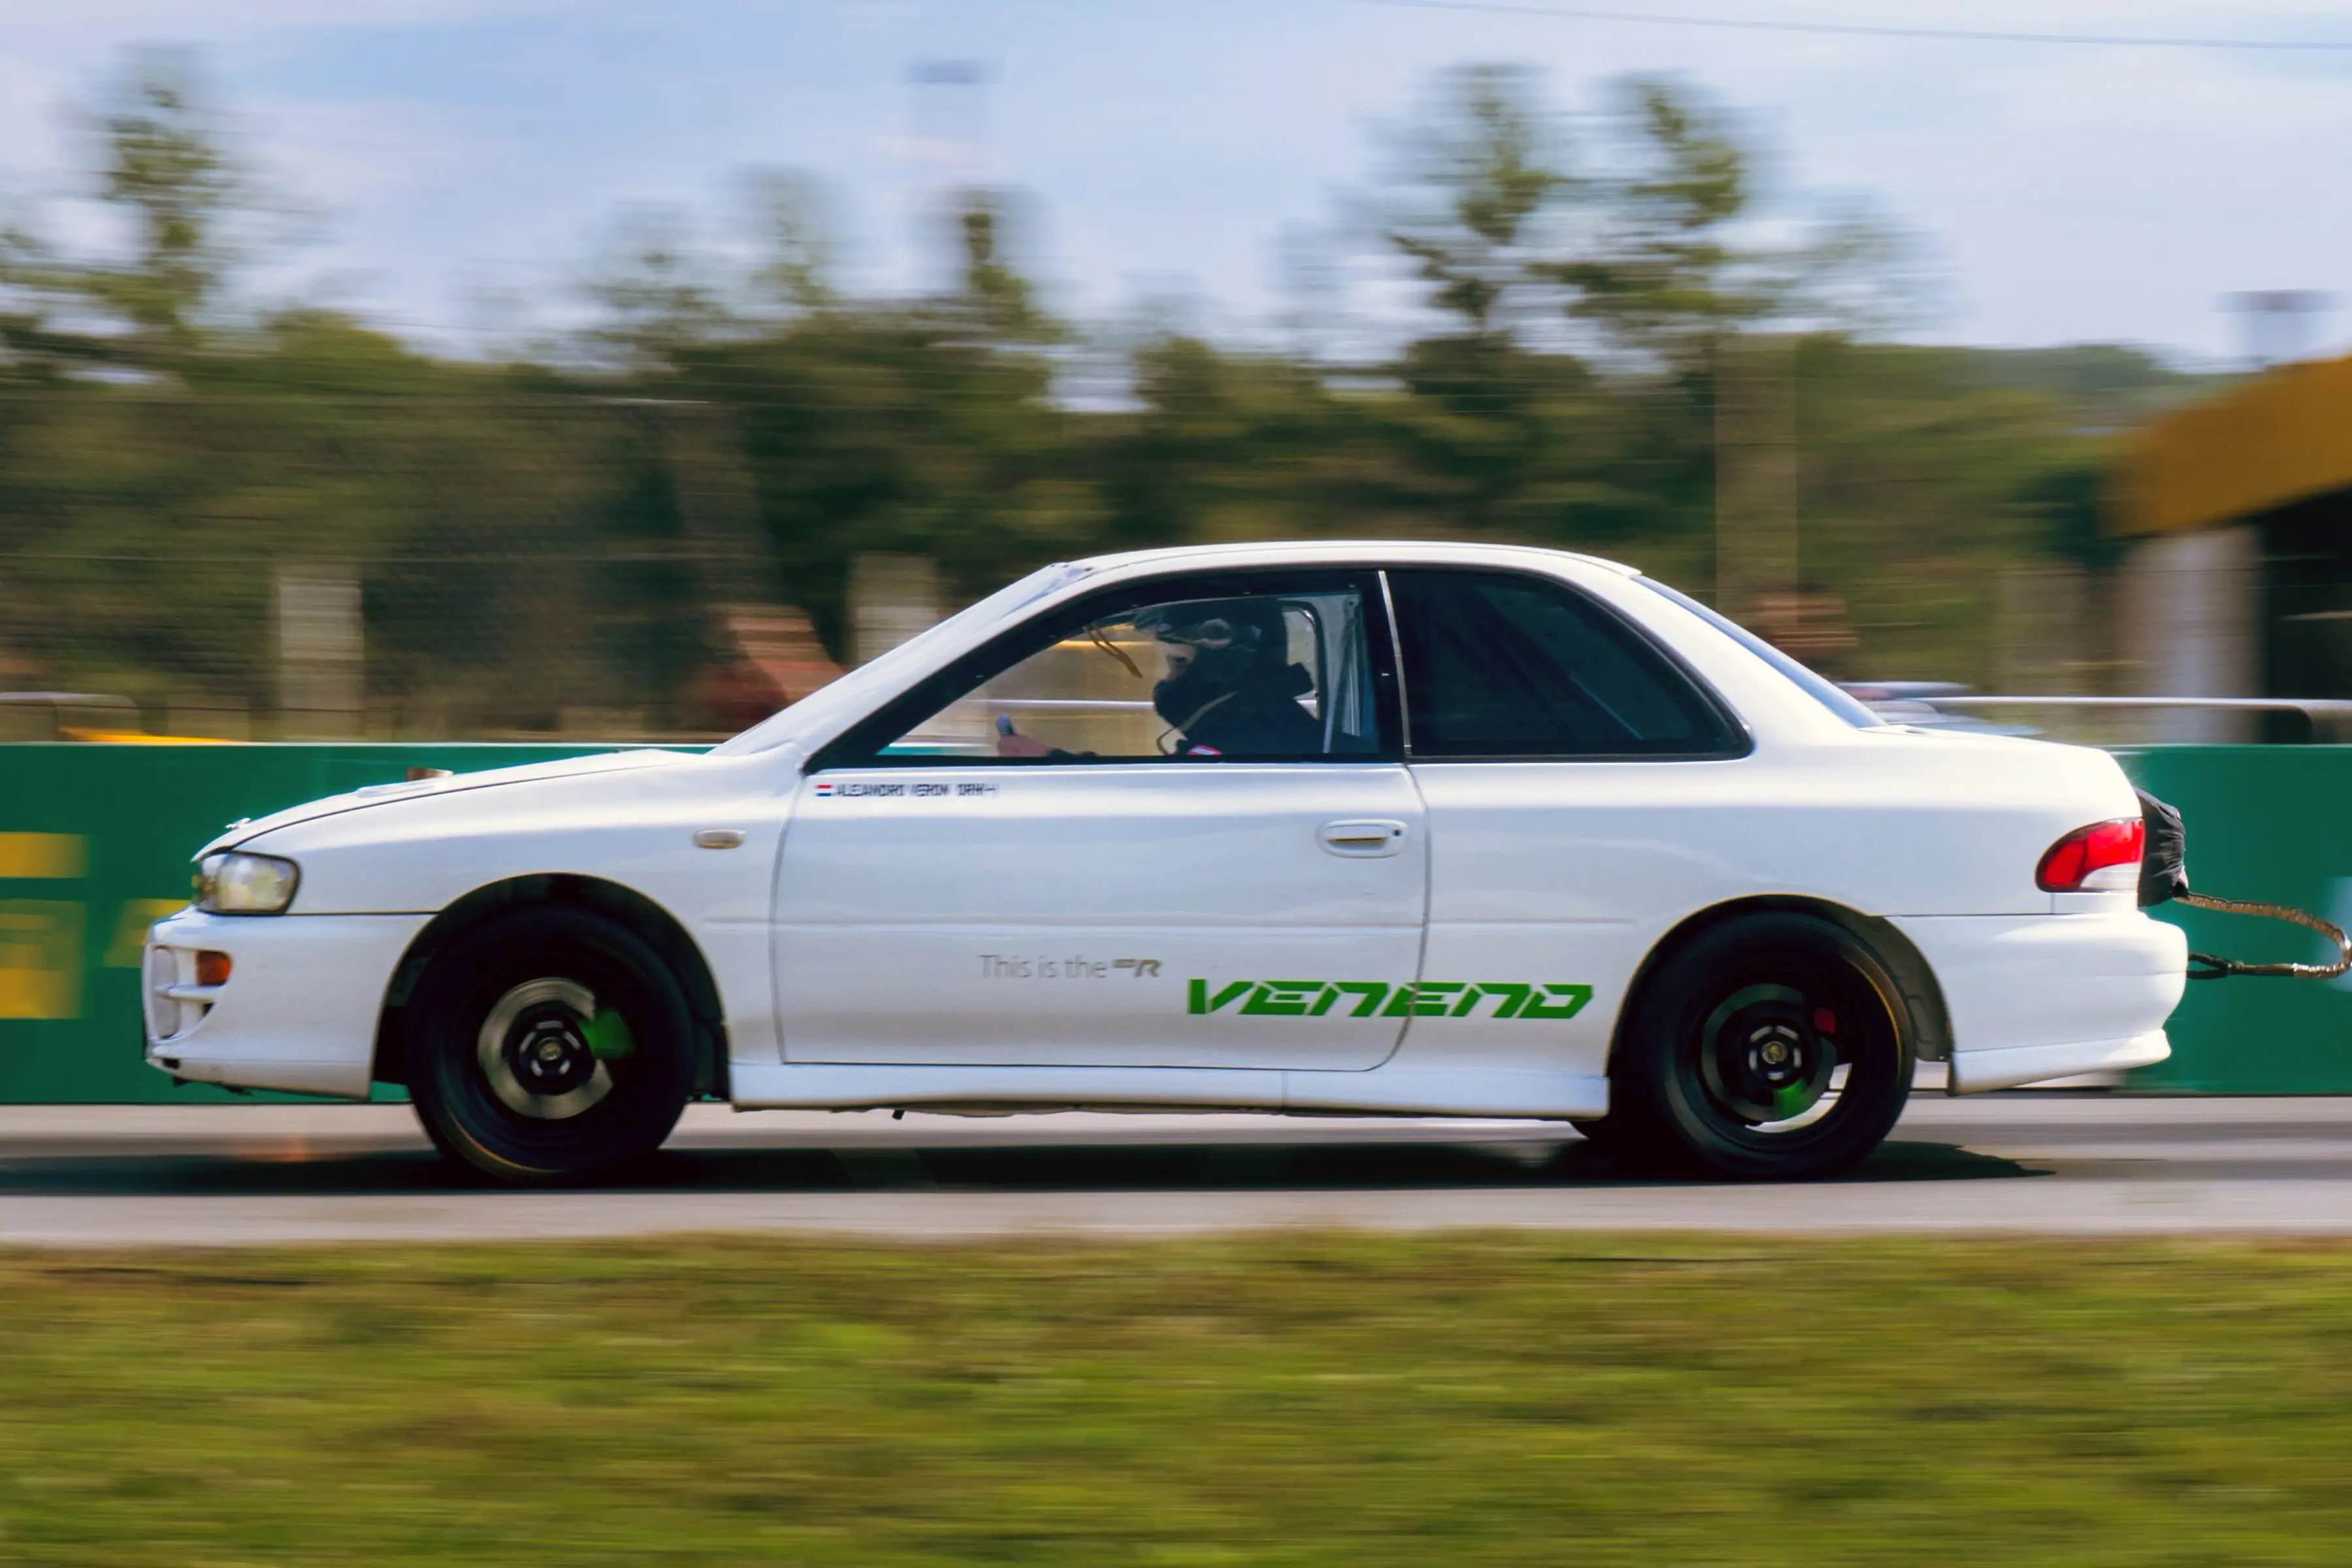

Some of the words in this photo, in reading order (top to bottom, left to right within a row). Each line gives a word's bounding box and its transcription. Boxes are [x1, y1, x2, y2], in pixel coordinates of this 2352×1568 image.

[977, 954, 1033, 979] This
[1037, 955, 1059, 979] is
[1063, 955, 1108, 979] the
[1187, 979, 1593, 1019] VENENO
